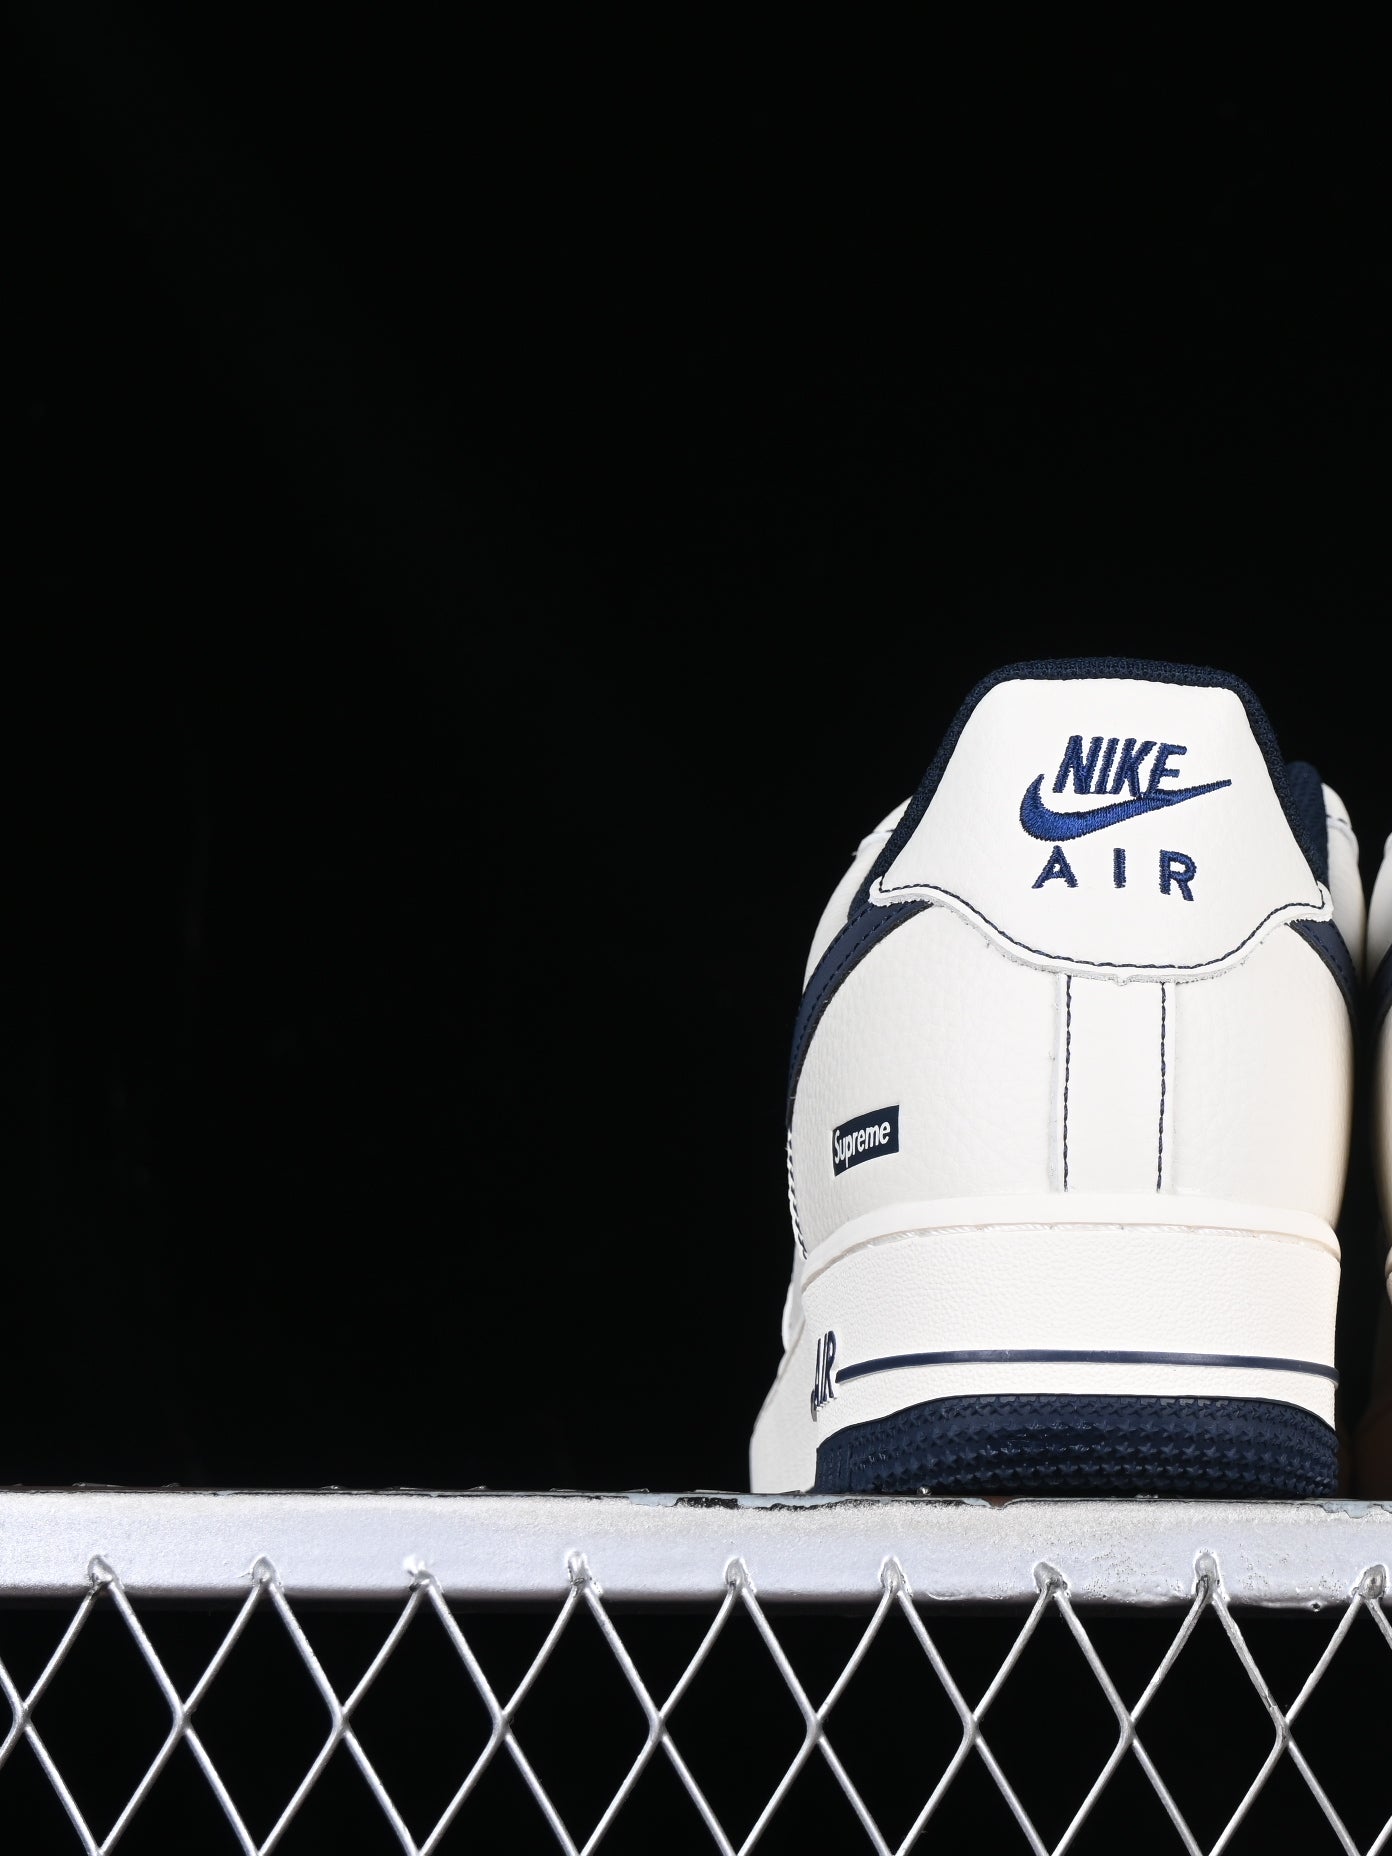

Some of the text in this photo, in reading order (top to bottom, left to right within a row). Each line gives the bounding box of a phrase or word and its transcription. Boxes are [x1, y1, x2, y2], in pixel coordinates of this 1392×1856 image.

[1052, 735, 1187, 799] NIKE
[1031, 845, 1196, 901] AIR
[834, 1121, 891, 1168] Supreme
